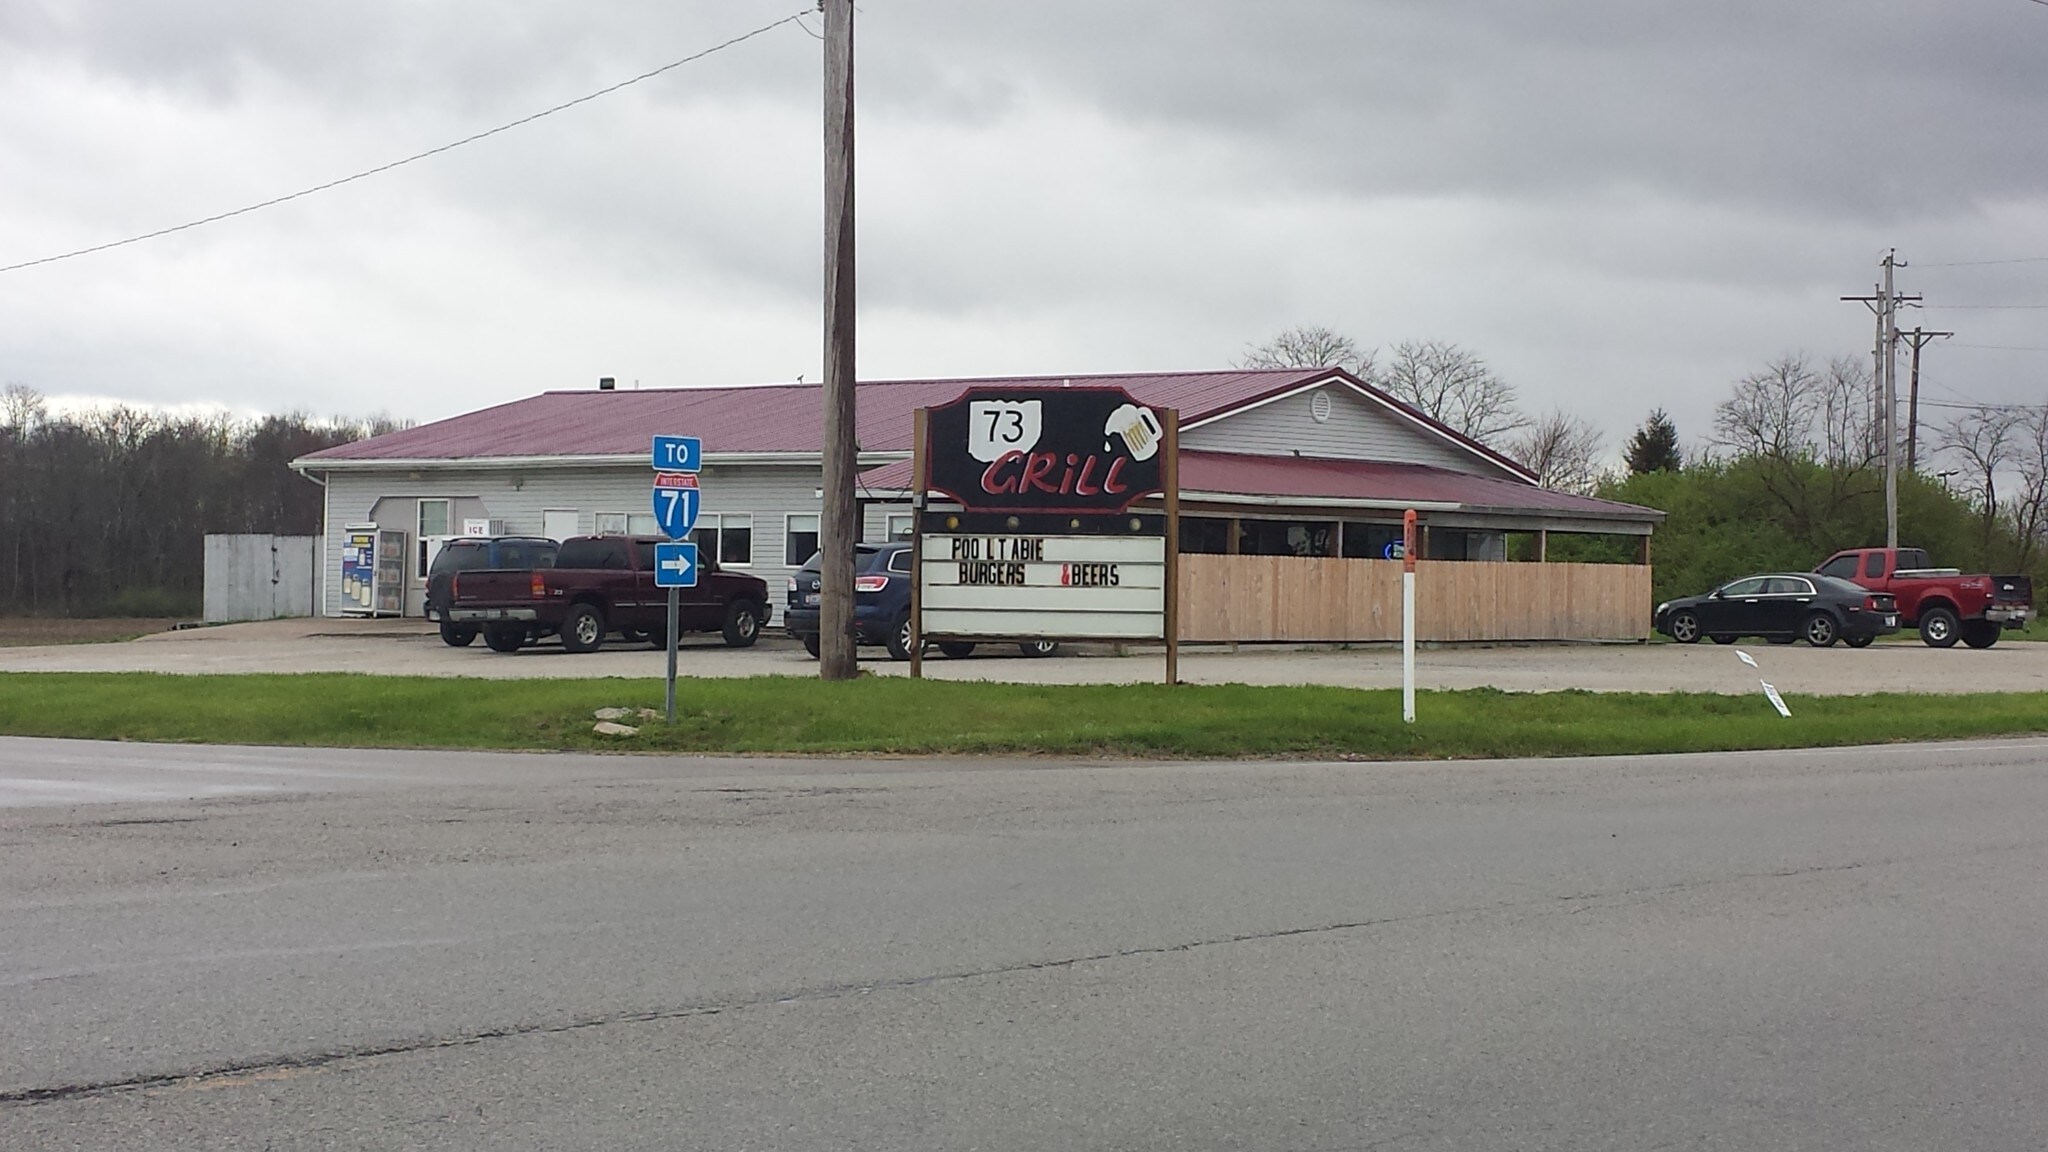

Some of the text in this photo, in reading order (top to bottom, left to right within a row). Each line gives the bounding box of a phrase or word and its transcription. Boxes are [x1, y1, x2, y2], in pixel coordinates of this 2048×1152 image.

[982, 410, 1024, 443] 73
[665, 443, 688, 463] TO
[660, 477, 694, 487] INTERSTATE
[661, 490, 689, 528] 71
[469, 526, 483, 535] ICE
[959, 563, 1025, 585] BURGERS
